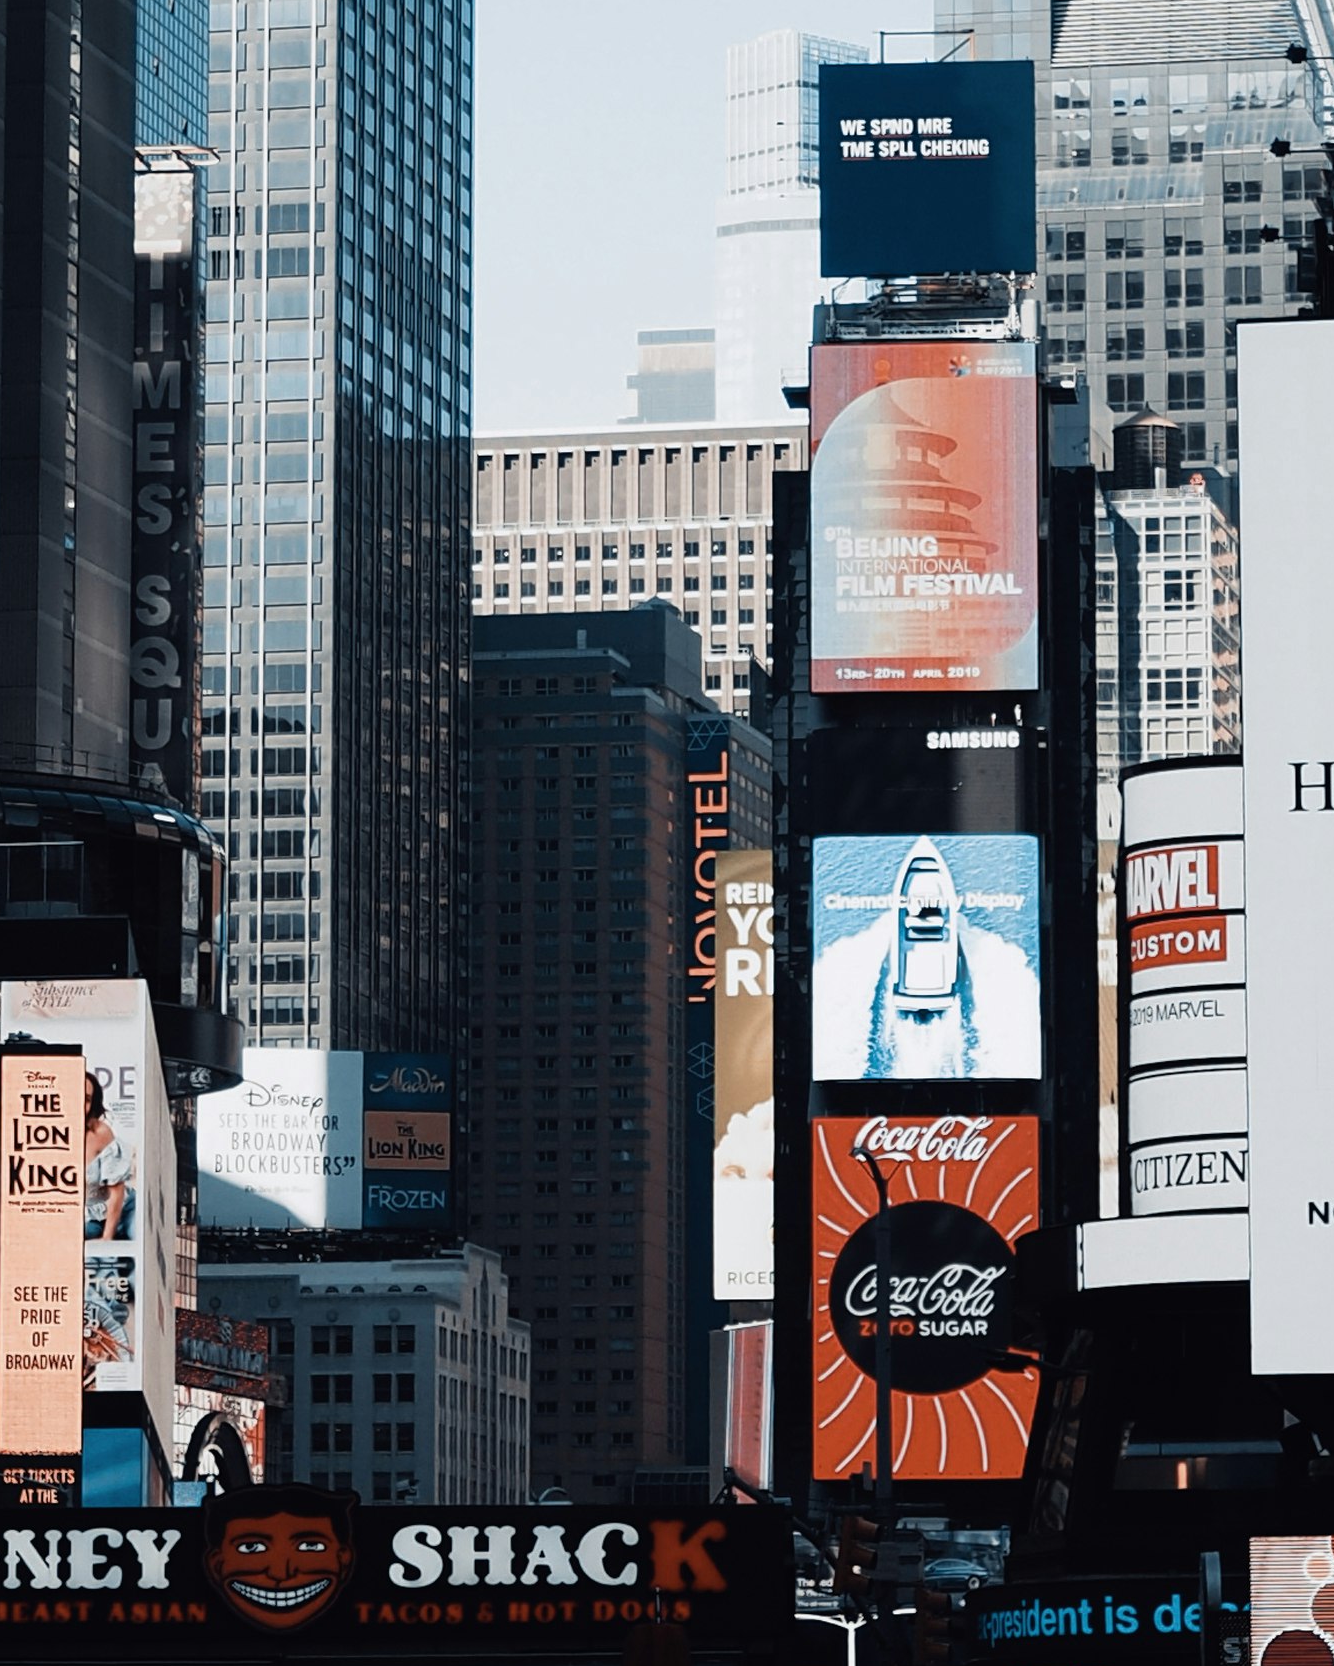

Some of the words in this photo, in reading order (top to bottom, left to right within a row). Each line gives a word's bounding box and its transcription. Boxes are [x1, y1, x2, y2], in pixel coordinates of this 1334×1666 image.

[840, 119, 867, 136] WE
[870, 118, 914, 136] SPND
[917, 117, 953, 135] MRE
[878, 140, 917, 157] SPLL
[920, 139, 990, 156] CHEKING
[132, 240, 182, 535] TIMES
[836, 536, 938, 558] BEIJING
[836, 558, 973, 574] INTERNATIONAL
[836, 575, 896, 596] FILM
[903, 573, 1022, 596] FESTIVAL
[913, 668, 944, 679] APRIL
[947, 666, 980, 678] 2019
[926, 731, 1020, 749] SAMSUNG
[824, 893, 907, 909] Cinematc
[966, 891, 1024, 912] Display
[1131, 930, 1220, 963] CUSTOM
[1156, 1000, 1225, 1021] MARVEL
[370, 1067, 446, 1095] Aladdin
[21, 1094, 62, 1113] THE
[219, 1113, 249, 1130] SETS
[254, 1113, 277, 1129] THE
[284, 1114, 308, 1130] BAR
[314, 1115, 339, 1131] FOR
[398, 1125, 415, 1136] THE
[13, 1118, 70, 1152] LION
[232, 1132, 326, 1151] BROADWAY
[852, 1116, 993, 1162] Coca-Cola
[369, 1137, 404, 1159] LION
[408, 1137, 445, 1160] KING
[9, 1156, 78, 1196] KING
[1134, 1150, 1248, 1194] CITIZEN
[369, 1185, 446, 1213] FROZEN
[14, 1286, 39, 1303] SEE
[44, 1286, 69, 1303] THE
[20, 1309, 62, 1325] PRIDE
[919, 1321, 988, 1336] SUGAR
[32, 1331, 49, 1348] OF
[6, 1354, 76, 1371] BROADWAY
[3, 1469, 24, 1484] GET
[28, 1469, 75, 1484] TICKETS
[20, 1490, 35, 1504] AT
[37, 1490, 58, 1504] THE
[388, 1519, 728, 1594] SHACK
[107, 1599, 208, 1624] ASIAN
[356, 1601, 465, 1624] TACOS
[476, 1601, 496, 1623] &
[507, 1601, 578, 1623] HOT
[592, 1599, 692, 1622] DOGS
[1103, 1594, 1140, 1634] is
